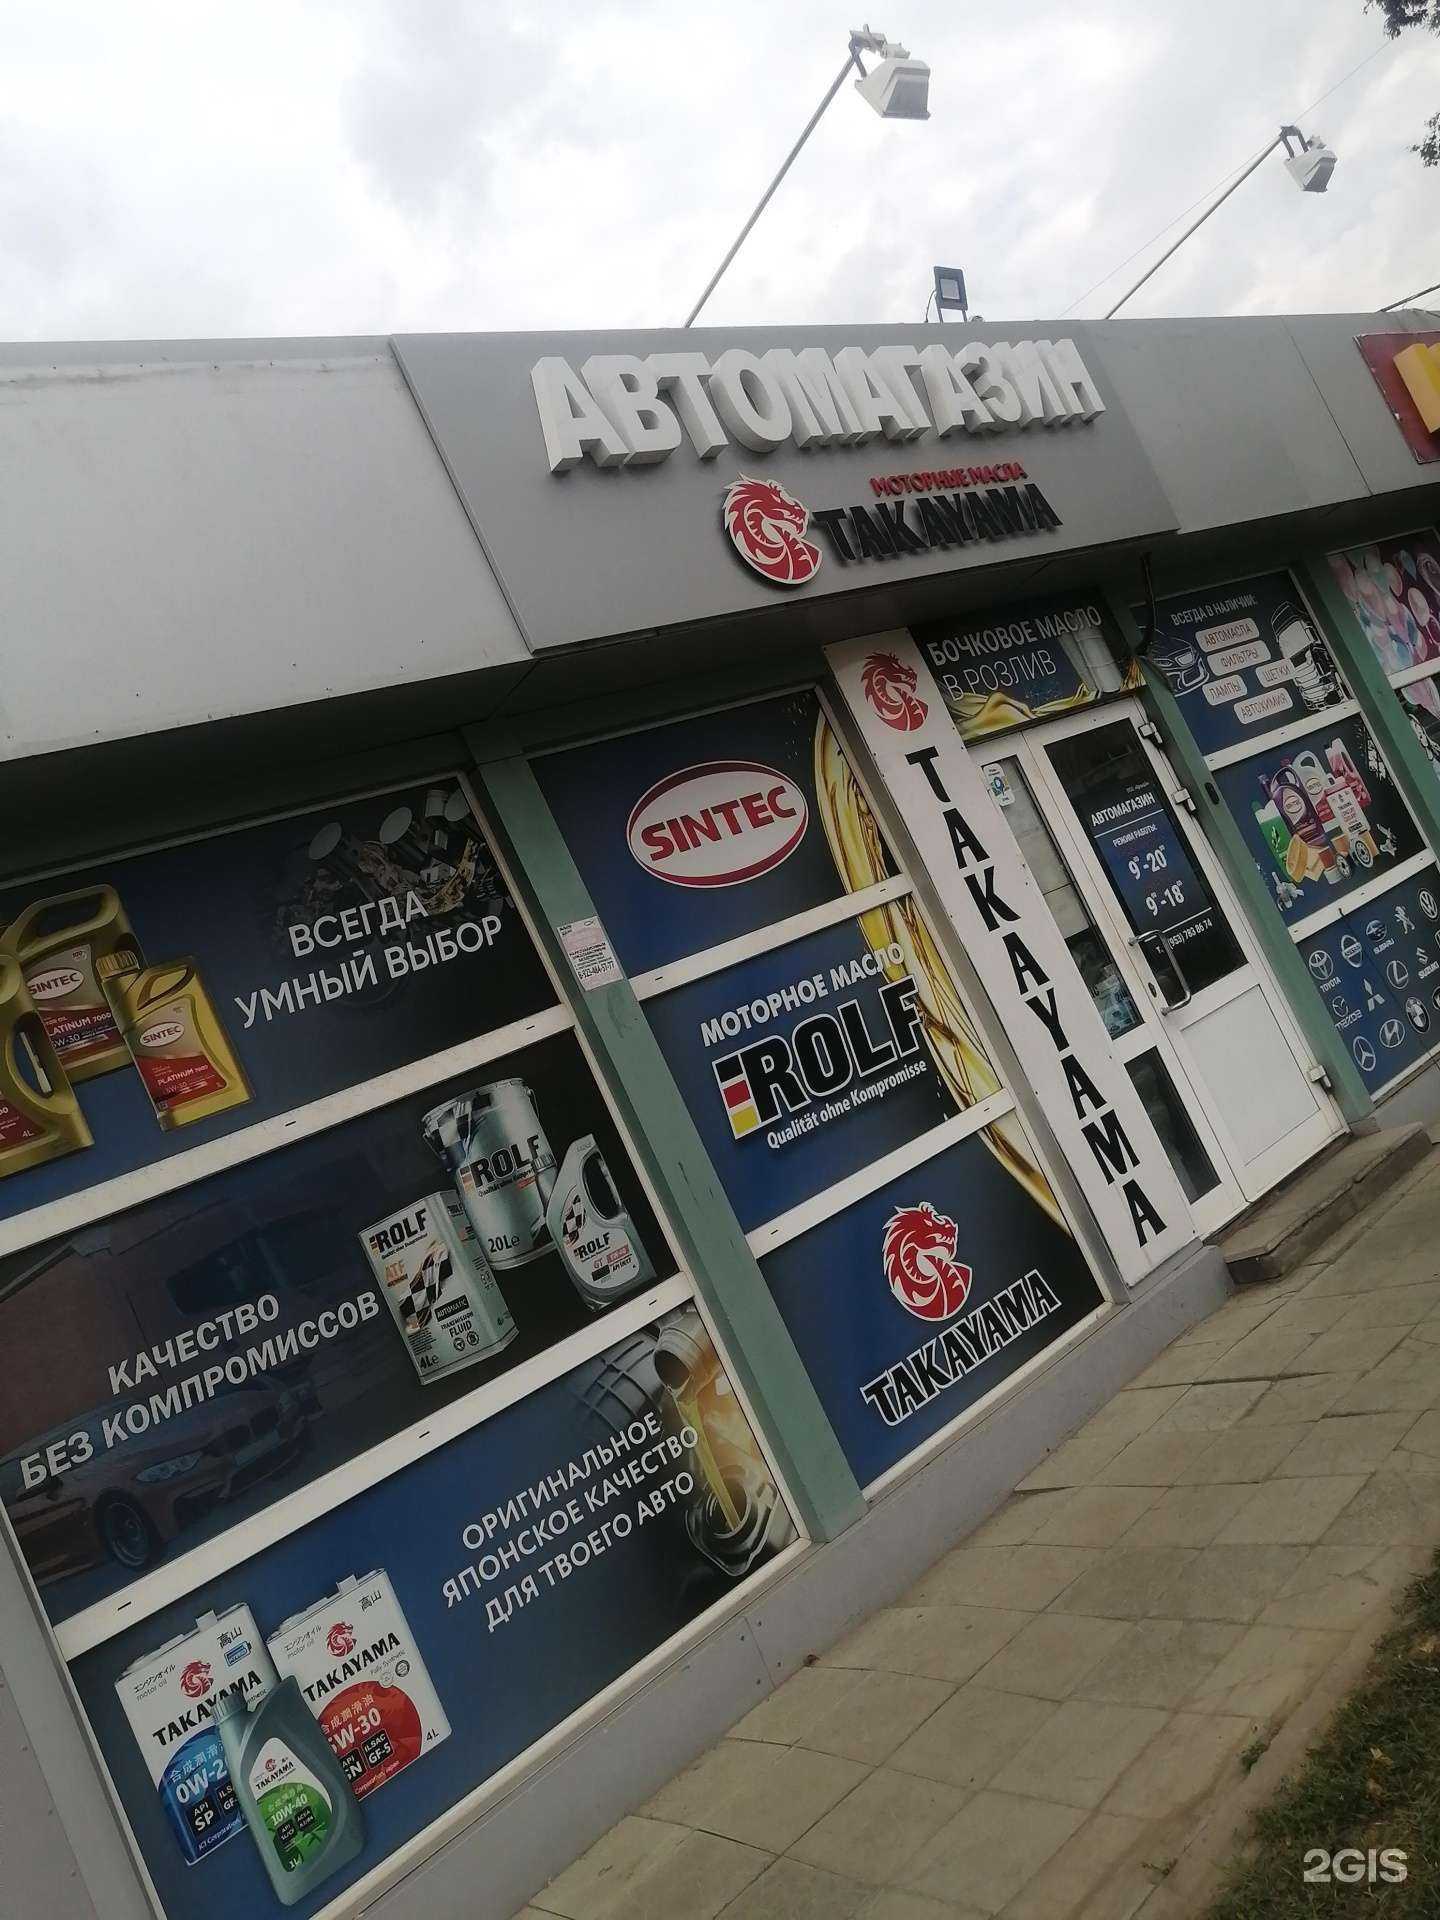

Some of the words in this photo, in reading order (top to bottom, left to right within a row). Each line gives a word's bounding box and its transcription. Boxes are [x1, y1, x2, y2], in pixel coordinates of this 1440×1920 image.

[530, 338, 1105, 472] АВТОМАГАЗИН
[811, 483, 1063, 561] TAKAYAMA
[1170, 606, 1208, 626] ВСЕГДА
[1208, 605, 1216, 617] В
[926, 622, 1037, 667] БОЧКОВОЕ
[1035, 605, 1102, 642] МАСЛО
[1204, 622, 1253, 647] АВТОМАСЛА
[1220, 648, 1259, 667] ФИЛЬТРЫ
[942, 674, 964, 701] В
[962, 649, 1057, 697] РОЗЛИВ
[1208, 680, 1242, 700] ЛАМПЫ
[1240, 692, 1287, 719] АВТОХИМИЯ
[640, 785, 797, 862] SINTEC
[1091, 792, 1156, 827] АВТОМАГАЗИН
[1112, 833, 1135, 848] РЕЖИМ
[288, 890, 429, 958] ВСЕГДА
[29, 972, 80, 995] SINTEC
[234, 950, 378, 1028] УМНЫЙ
[384, 915, 502, 979] ВЫБОР
[1320, 977, 1342, 992] TOYOTA
[700, 974, 830, 1047] МОТОРНОЕ
[829, 943, 905, 992] МАСЛО
[905, 745, 1168, 1249] TAKAYAMA
[49, 1017, 91, 1036] LATINUM
[143, 1025, 181, 1044] SINTEC
[738, 974, 920, 1125] ROLF
[157, 1068, 194, 1086] PLATINUM
[767, 1108, 820, 1149] Qualität
[819, 1100, 851, 1123] ohne
[849, 1059, 928, 1109] Kompromisse
[470, 1134, 539, 1188] ROLF
[375, 1208, 426, 1253] ROLF
[580, 1232, 610, 1259] ROLF
[449, 1320, 472, 1337] FLUID
[107, 1294, 280, 1395] КАЧЕСТВО
[860, 1268, 1062, 1426] TAKAYAMA
[20, 1431, 94, 1489] БЕЗ
[102, 1291, 380, 1449] КОМПРОМИССОВ
[462, 1412, 661, 1550] ОРИГИНАЛЬНОЕ
[442, 1499, 584, 1608] ЯПОНСКОЕ
[584, 1424, 698, 1513] КАЧЕСТВО
[485, 1575, 539, 1633] ДЛЯ
[538, 1513, 632, 1587] ТВОЕГО
[636, 1472, 694, 1525] АВТО
[359, 1590, 382, 1612] 高山
[217, 1625, 242, 1648] 高山
[303, 1632, 400, 1702] TAKAYAMA
[153, 1670, 262, 1746] TAKAYAMA
[364, 1734, 386, 1753] ILSAC
[426, 1729, 440, 1741] 4L
[342, 1756, 355, 1768] API
[368, 1742, 391, 1764] GF-5
[176, 1759, 228, 1803] 0W-2
[256, 1761, 294, 1790] TAKAYAMA
[218, 1785, 233, 1799] ILS
[223, 1797, 238, 1810] GF-
[194, 1802, 209, 1816] API
[195, 1810, 214, 1831] SP
[271, 1793, 308, 1826] 10W-40
